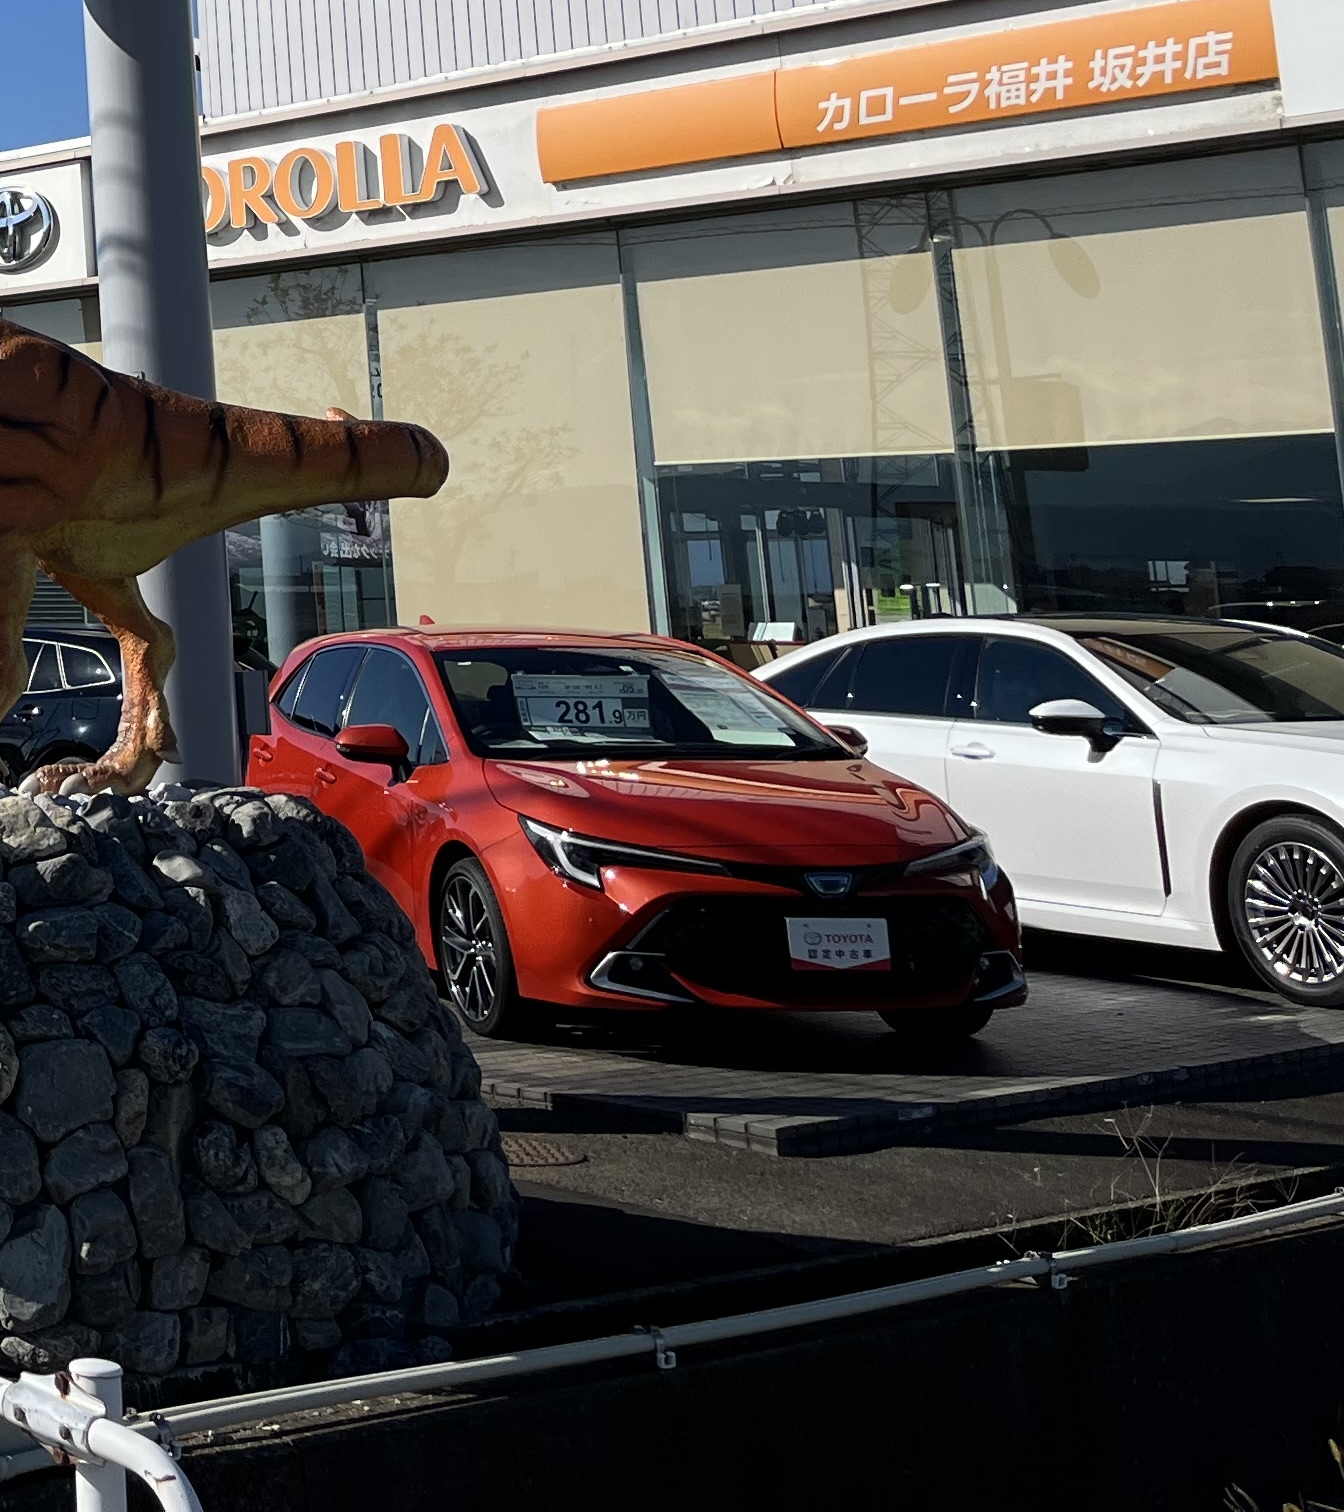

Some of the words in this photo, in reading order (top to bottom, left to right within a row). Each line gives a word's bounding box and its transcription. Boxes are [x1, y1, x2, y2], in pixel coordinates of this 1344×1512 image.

[816, 54, 1074, 133] カローラ福井
[1087, 31, 1233, 92] 坂井店
[555, 700, 622, 724] 281.9
[627, 710, 647, 721] 万円
[824, 933, 873, 943] TOYOTA
[808, 949, 872, 959] 認定中古車
